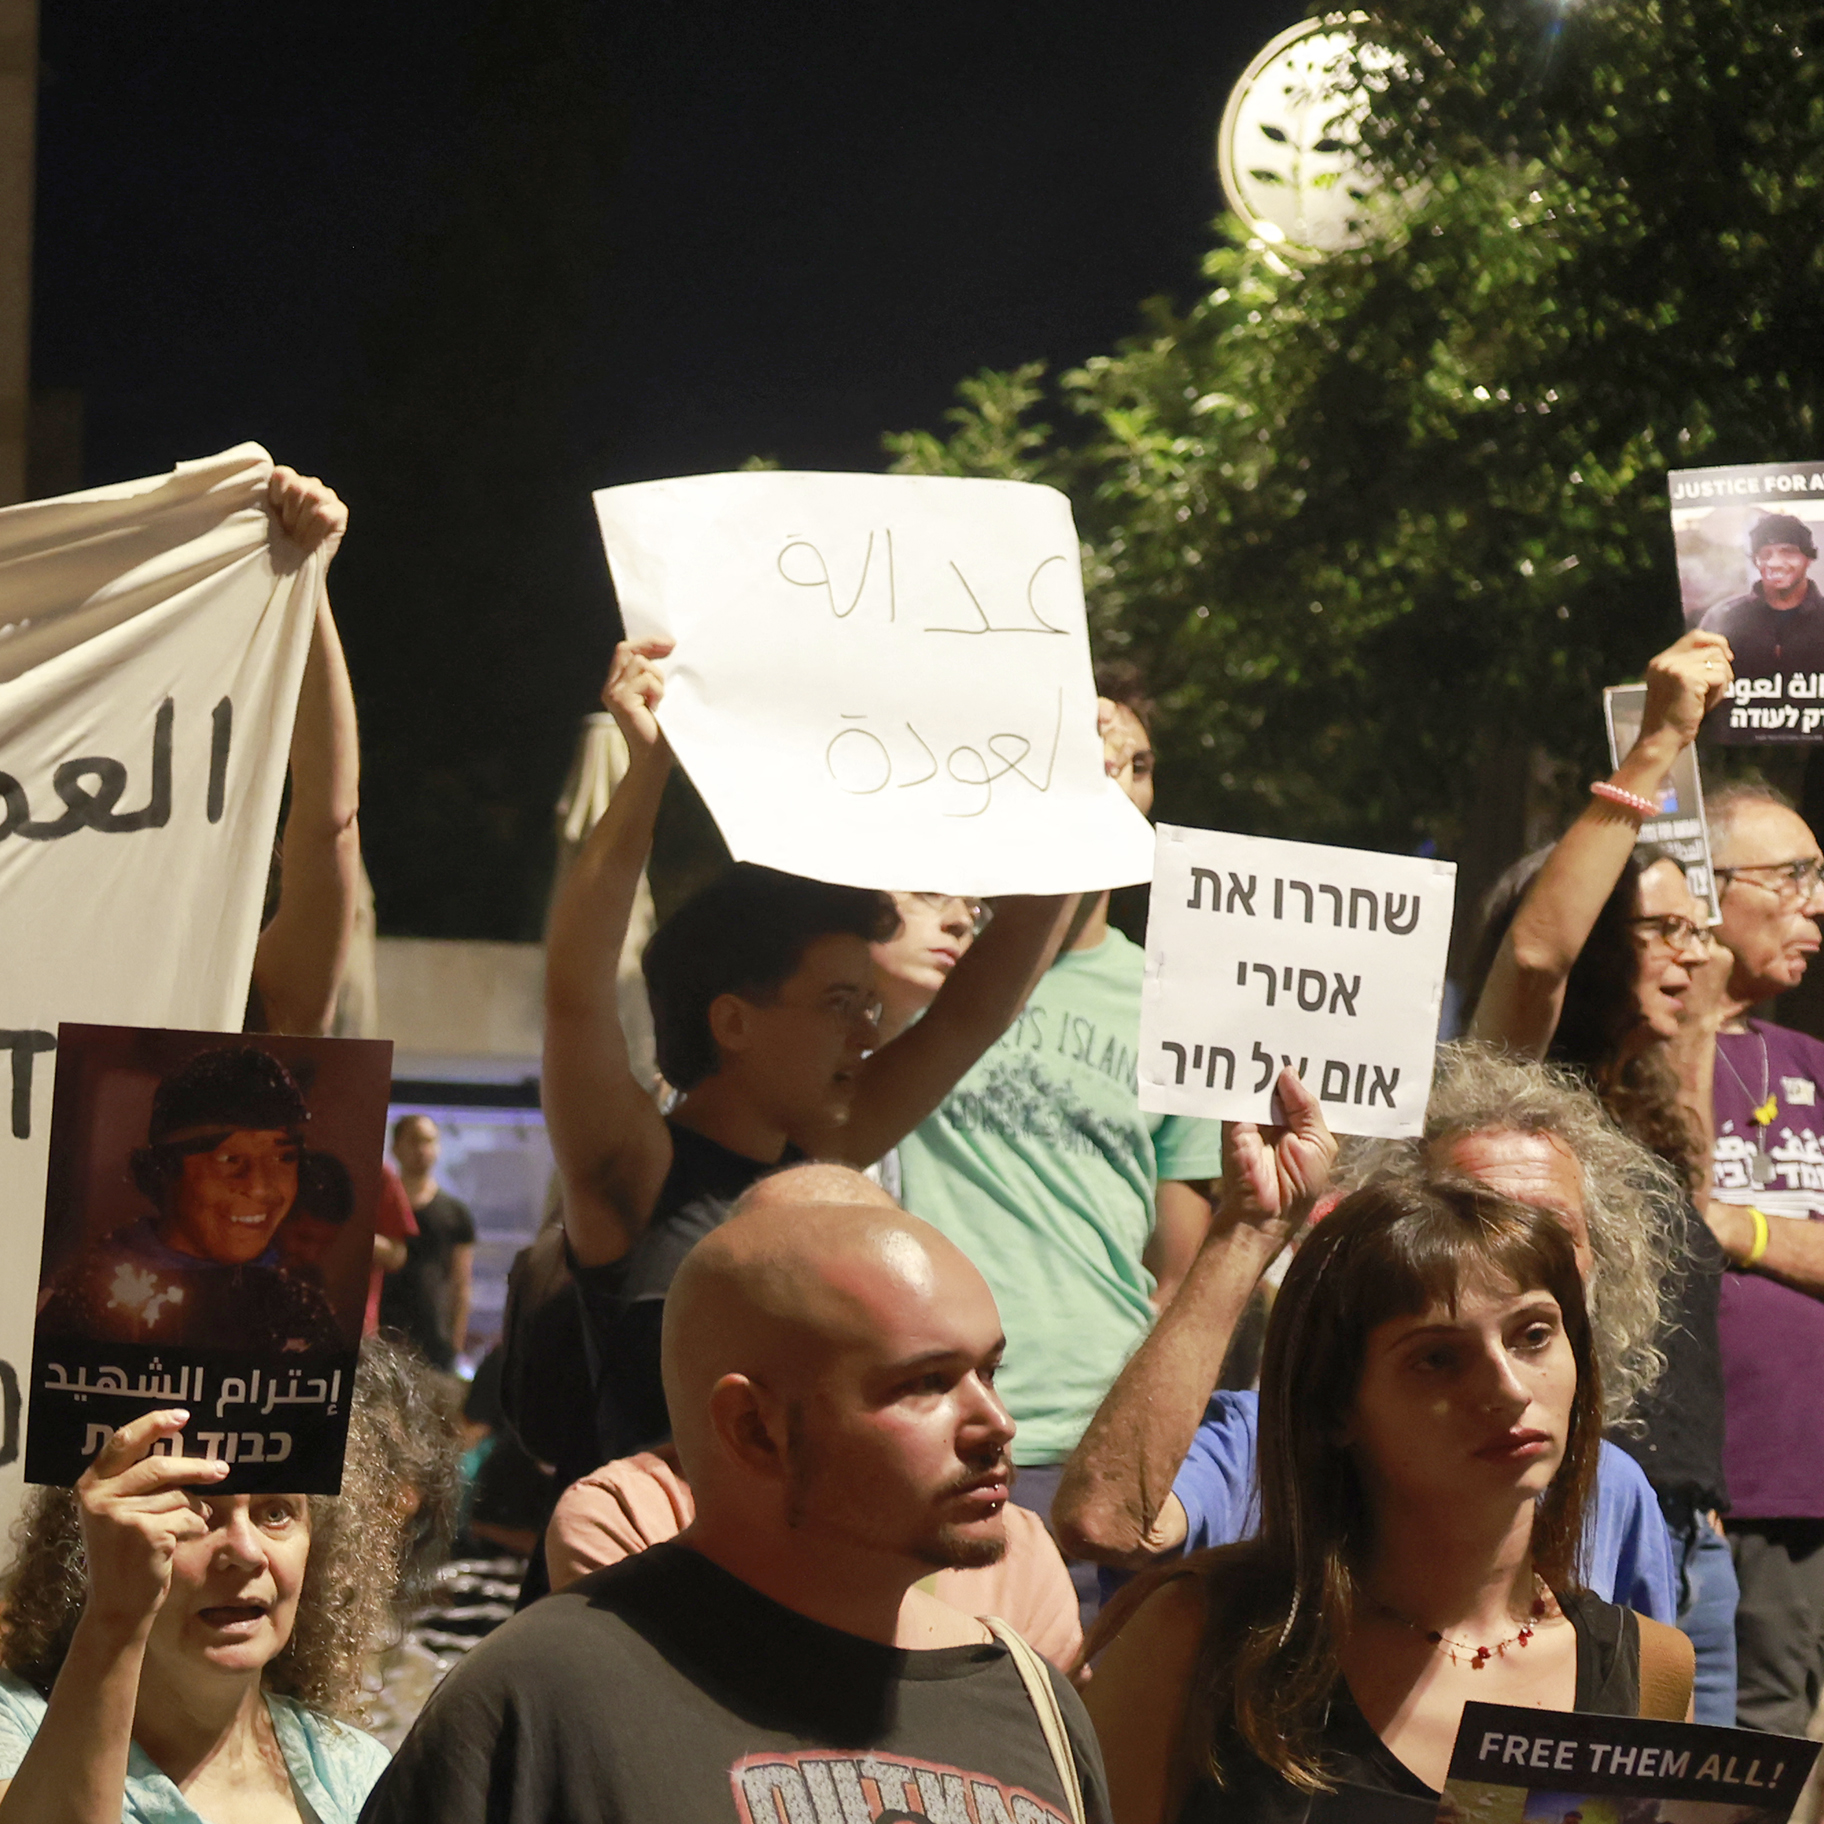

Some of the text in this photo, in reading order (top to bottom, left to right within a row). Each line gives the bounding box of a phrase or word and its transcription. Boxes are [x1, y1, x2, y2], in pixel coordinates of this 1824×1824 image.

[1673, 478, 1760, 501] JUSTICE
[1764, 473, 1808, 494] FOR
[1723, 671, 1784, 706] لعود
[1729, 703, 1800, 729] לעודה
[1186, 866, 1421, 936] שחררו את
[1236, 960, 1362, 1017] אסירי
[1161, 1040, 1237, 1091] חיר
[1319, 1058, 1401, 1109] אום
[44, 1356, 204, 1404] الشهيد
[196, 1431, 293, 1464] כבוד
[1478, 1731, 1785, 1789] FREE THEM ALL!
